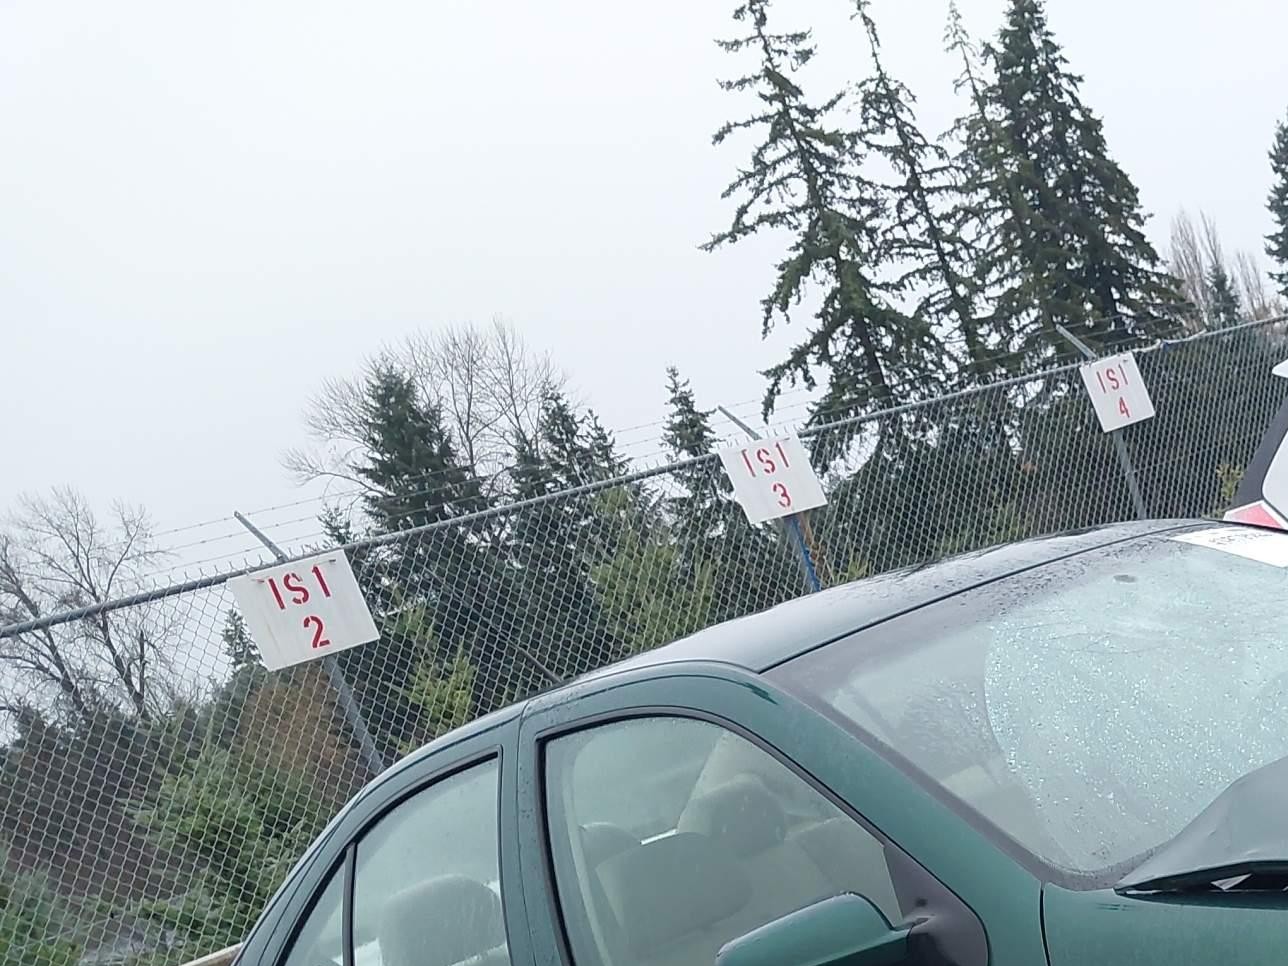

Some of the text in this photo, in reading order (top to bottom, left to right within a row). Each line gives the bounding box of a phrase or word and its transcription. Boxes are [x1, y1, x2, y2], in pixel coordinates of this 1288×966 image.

[1119, 396, 1130, 418] 4
[773, 483, 791, 508] 3
[303, 615, 330, 649] 2
